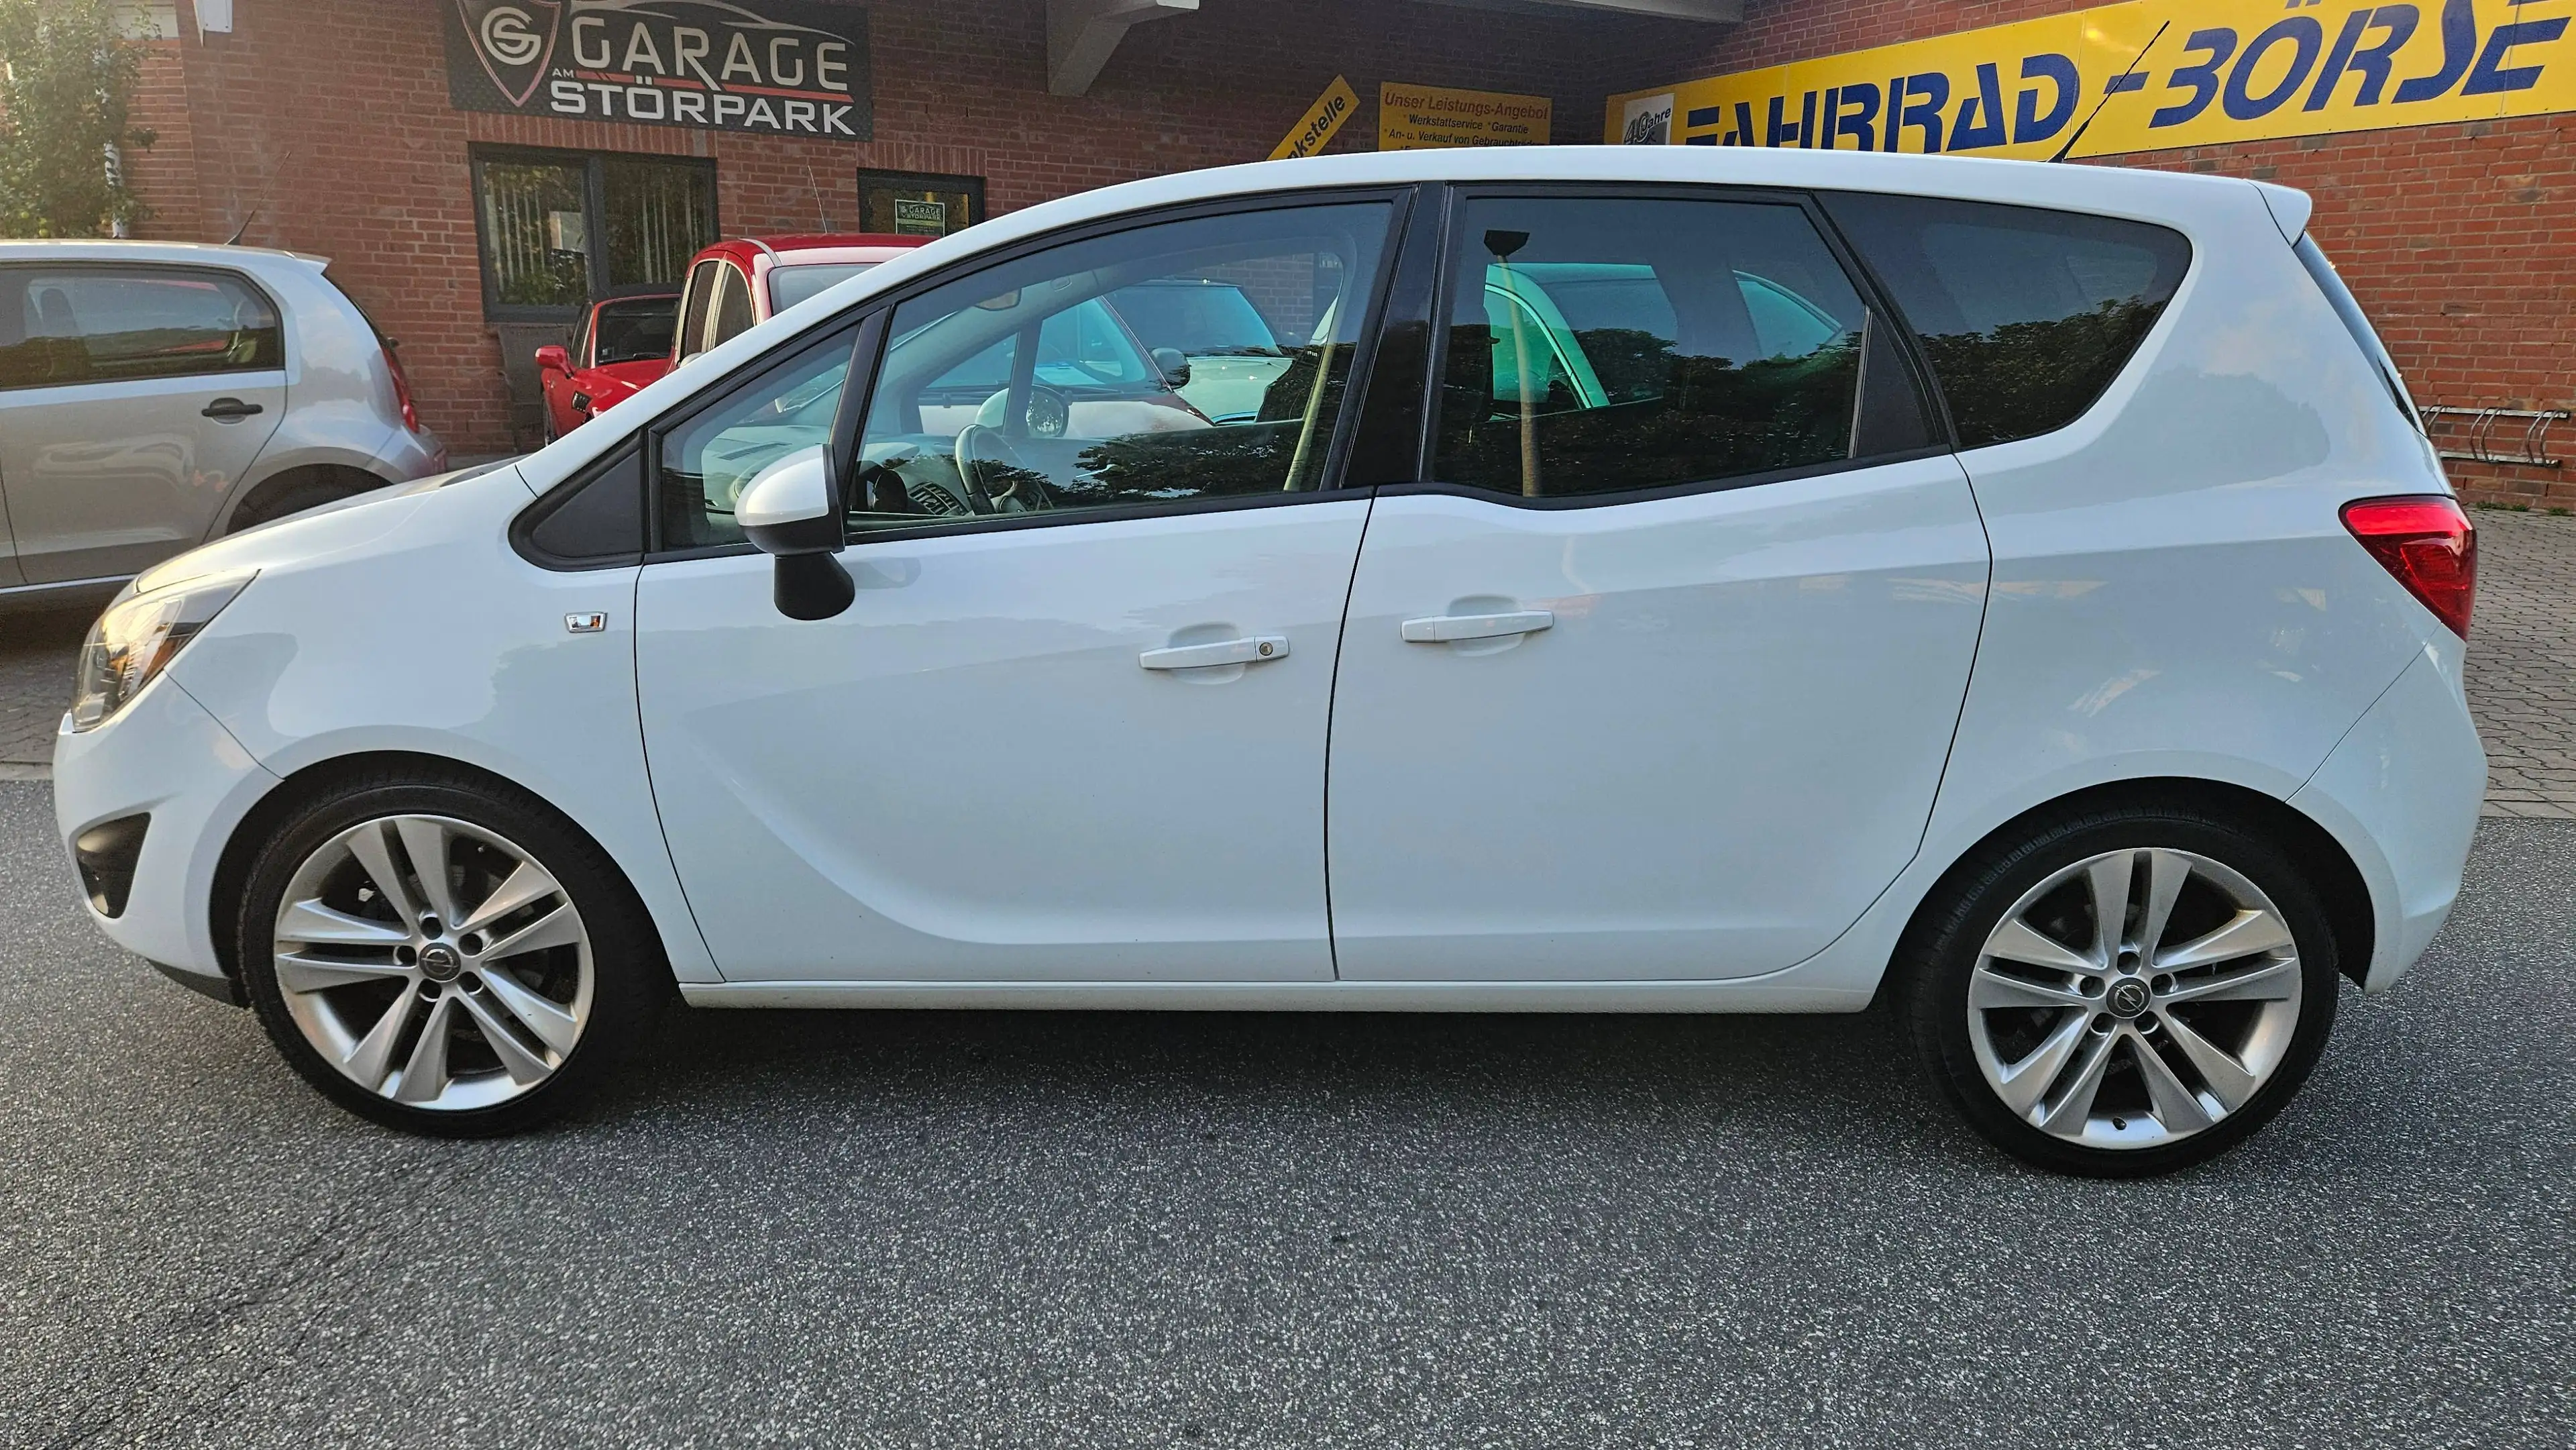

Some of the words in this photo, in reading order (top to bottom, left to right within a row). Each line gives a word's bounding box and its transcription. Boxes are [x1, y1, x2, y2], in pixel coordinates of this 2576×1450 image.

[572, 16, 849, 92] GARAGE
[552, 68, 575, 79] AM
[550, 75, 857, 135] STÖRPARK
[1385, 91, 1426, 108] Unser
[1428, 96, 1548, 120] Leistungs-Angebot
[1389, 128, 1405, 139] An-
[1419, 131, 1453, 143] Verkauf
[1454, 136, 1469, 144] von
[1409, 113, 1483, 130] Werkstattservice
[1491, 121, 1529, 134] Garantie
[1623, 111, 1651, 143] 40
